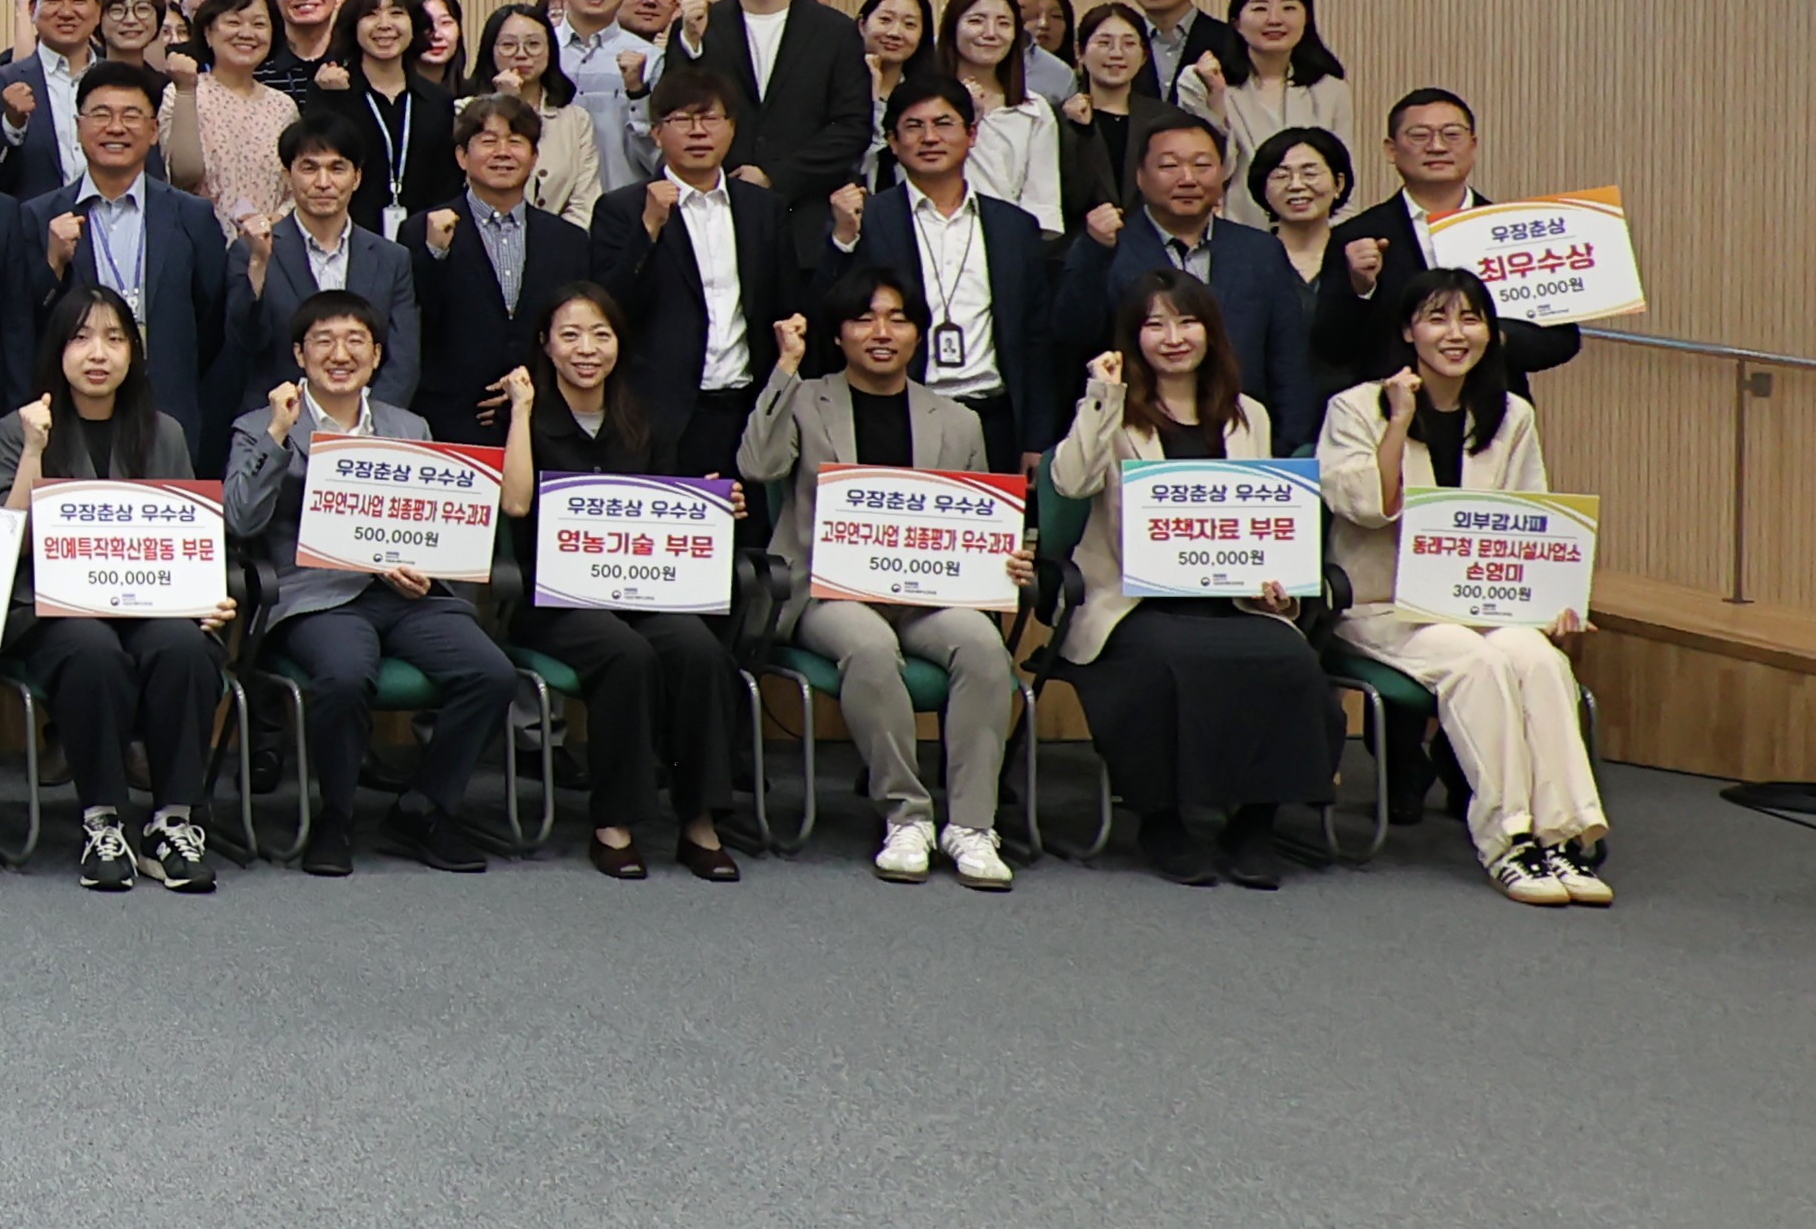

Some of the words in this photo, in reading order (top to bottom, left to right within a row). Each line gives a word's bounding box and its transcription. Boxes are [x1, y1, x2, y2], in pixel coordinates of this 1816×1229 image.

[1491, 217, 1566, 243] 우장춘상
[1477, 242, 1595, 283] 최우수상
[1499, 277, 1585, 303] 500,000원
[336, 459, 411, 482] 우장춘상
[418, 467, 475, 488] 우수상
[846, 489, 927, 511] 우장춘상
[934, 495, 995, 516] 우수상
[1151, 484, 1228, 503] 우장춘상
[1235, 484, 1292, 502] 우수상
[60, 503, 133, 522] 우장춘상
[141, 504, 196, 523] 우수상
[310, 490, 384, 518] 고유연구사업
[387, 496, 437, 523] 최종평가
[441, 501, 491, 527] 우수과제
[567, 497, 643, 517] 우장춘상
[650, 500, 707, 520] 우수상
[1147, 517, 1241, 541] 정책자료
[1249, 518, 1295, 541] 부문
[1453, 511, 1548, 533] 외부감사패
[354, 526, 439, 548] 500,000원
[557, 529, 655, 556] 영농기술
[665, 535, 714, 559] 부문
[821, 520, 900, 548] 고유연구사업
[904, 526, 957, 551] 최종평가
[961, 530, 1015, 555] 우수과제
[1412, 535, 1473, 557] 동래구청
[1478, 538, 1581, 562] 문화시설사업소
[44, 537, 175, 561] 원예특작확산활동
[182, 539, 214, 562] 부문
[1178, 550, 1265, 566] 500,000원
[88, 570, 172, 586] 500,000원
[590, 564, 676, 581] 500,000원
[869, 557, 961, 576] 500,000원
[1466, 561, 1524, 583] 손영미
[1453, 584, 1532, 601] 300,000원
